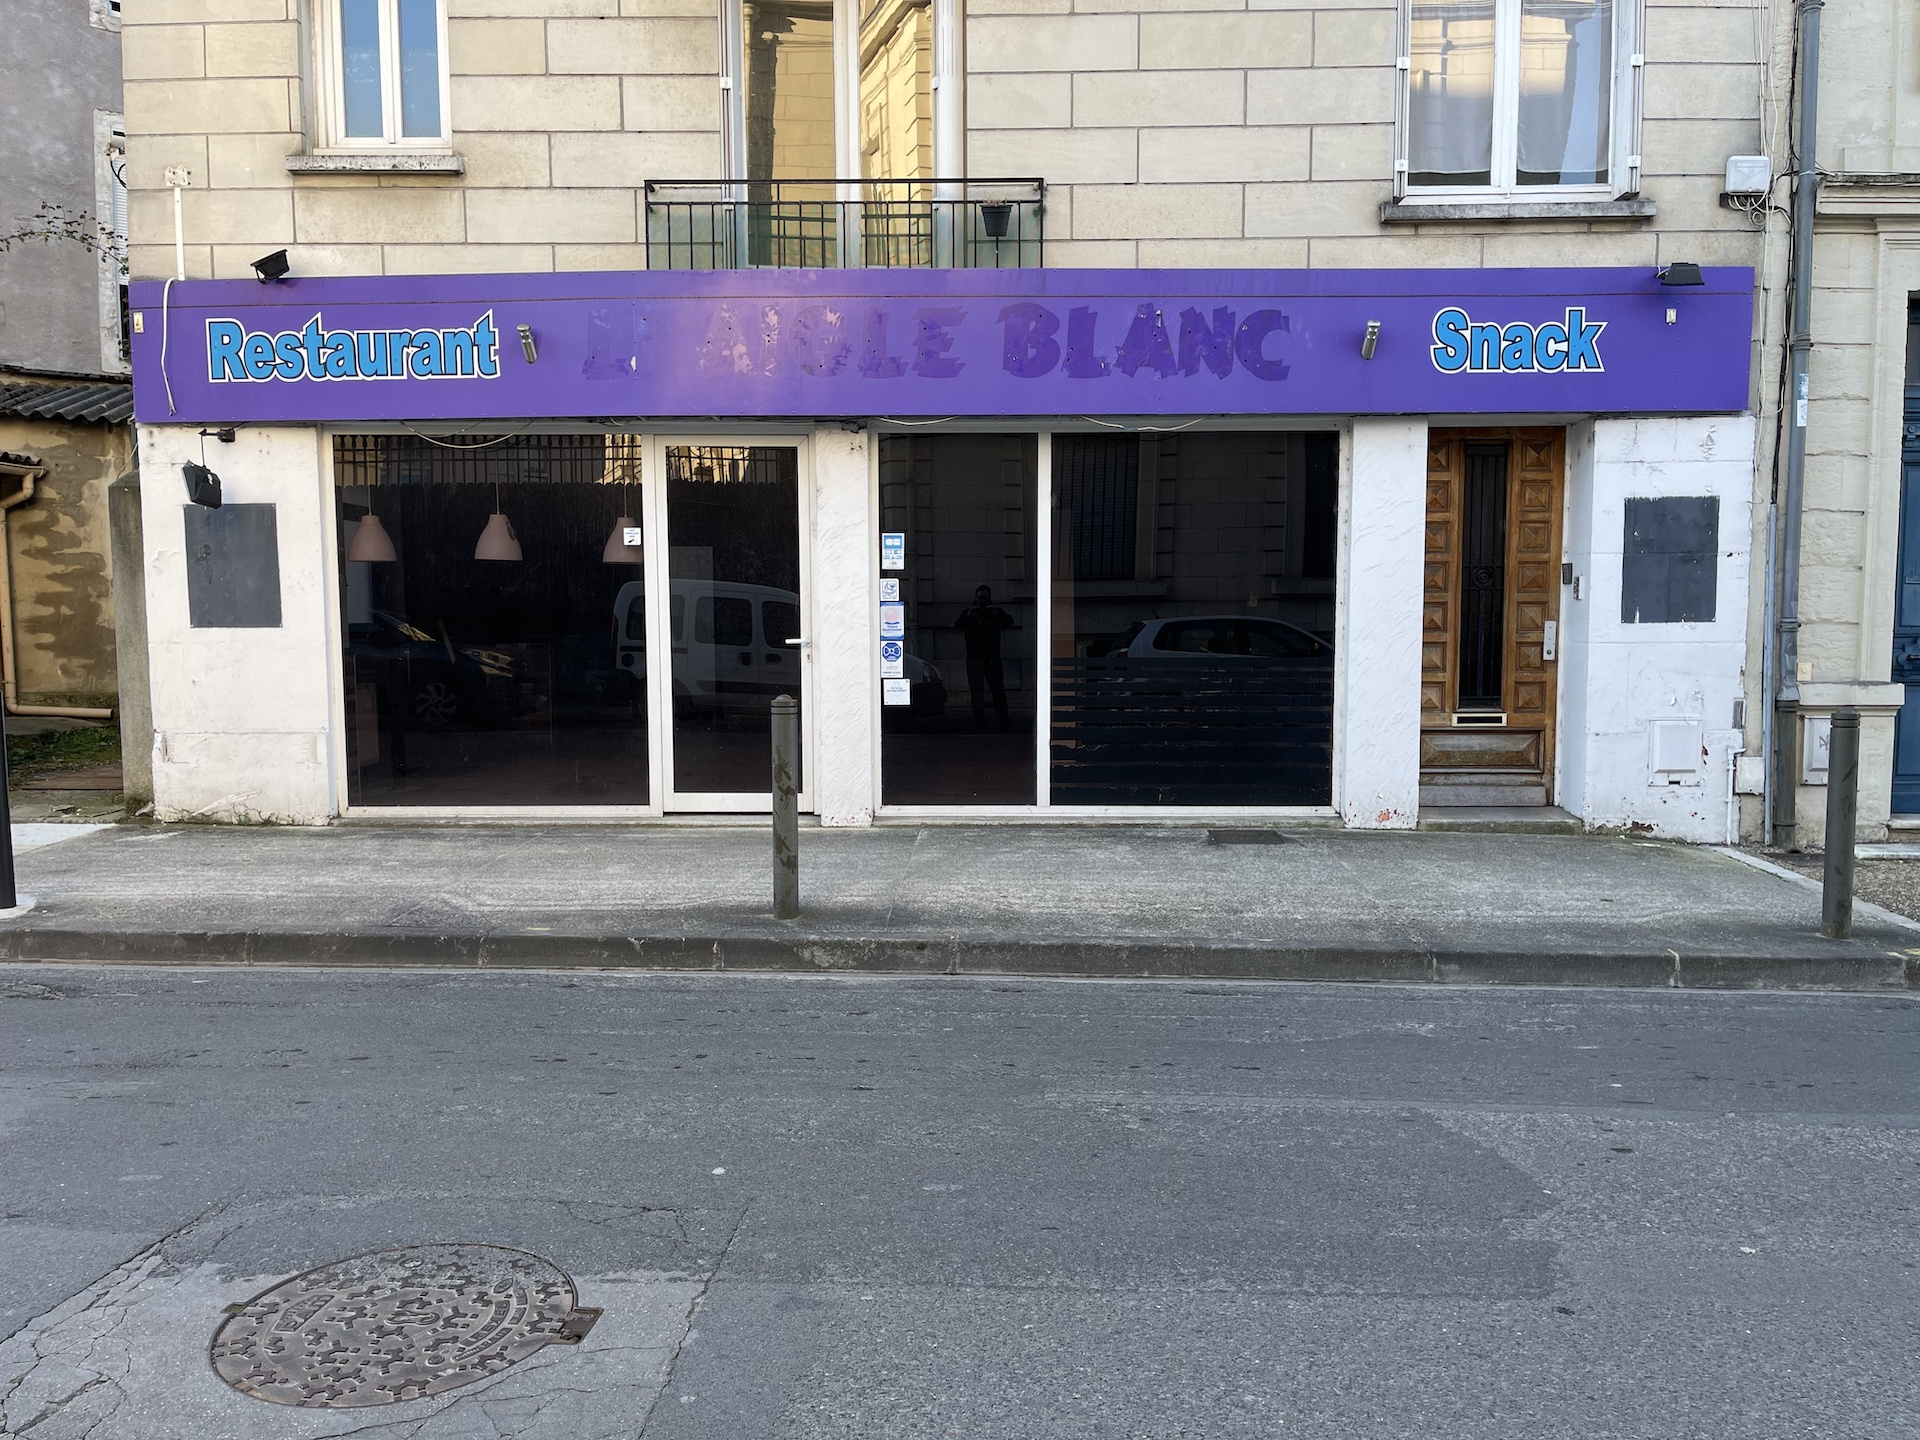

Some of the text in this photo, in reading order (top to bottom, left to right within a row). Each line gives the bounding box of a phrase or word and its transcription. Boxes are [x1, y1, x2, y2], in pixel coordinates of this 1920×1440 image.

[205, 308, 500, 382] Restaurant
[995, 302, 1290, 381] BLANC
[1430, 307, 1608, 373] Snack
